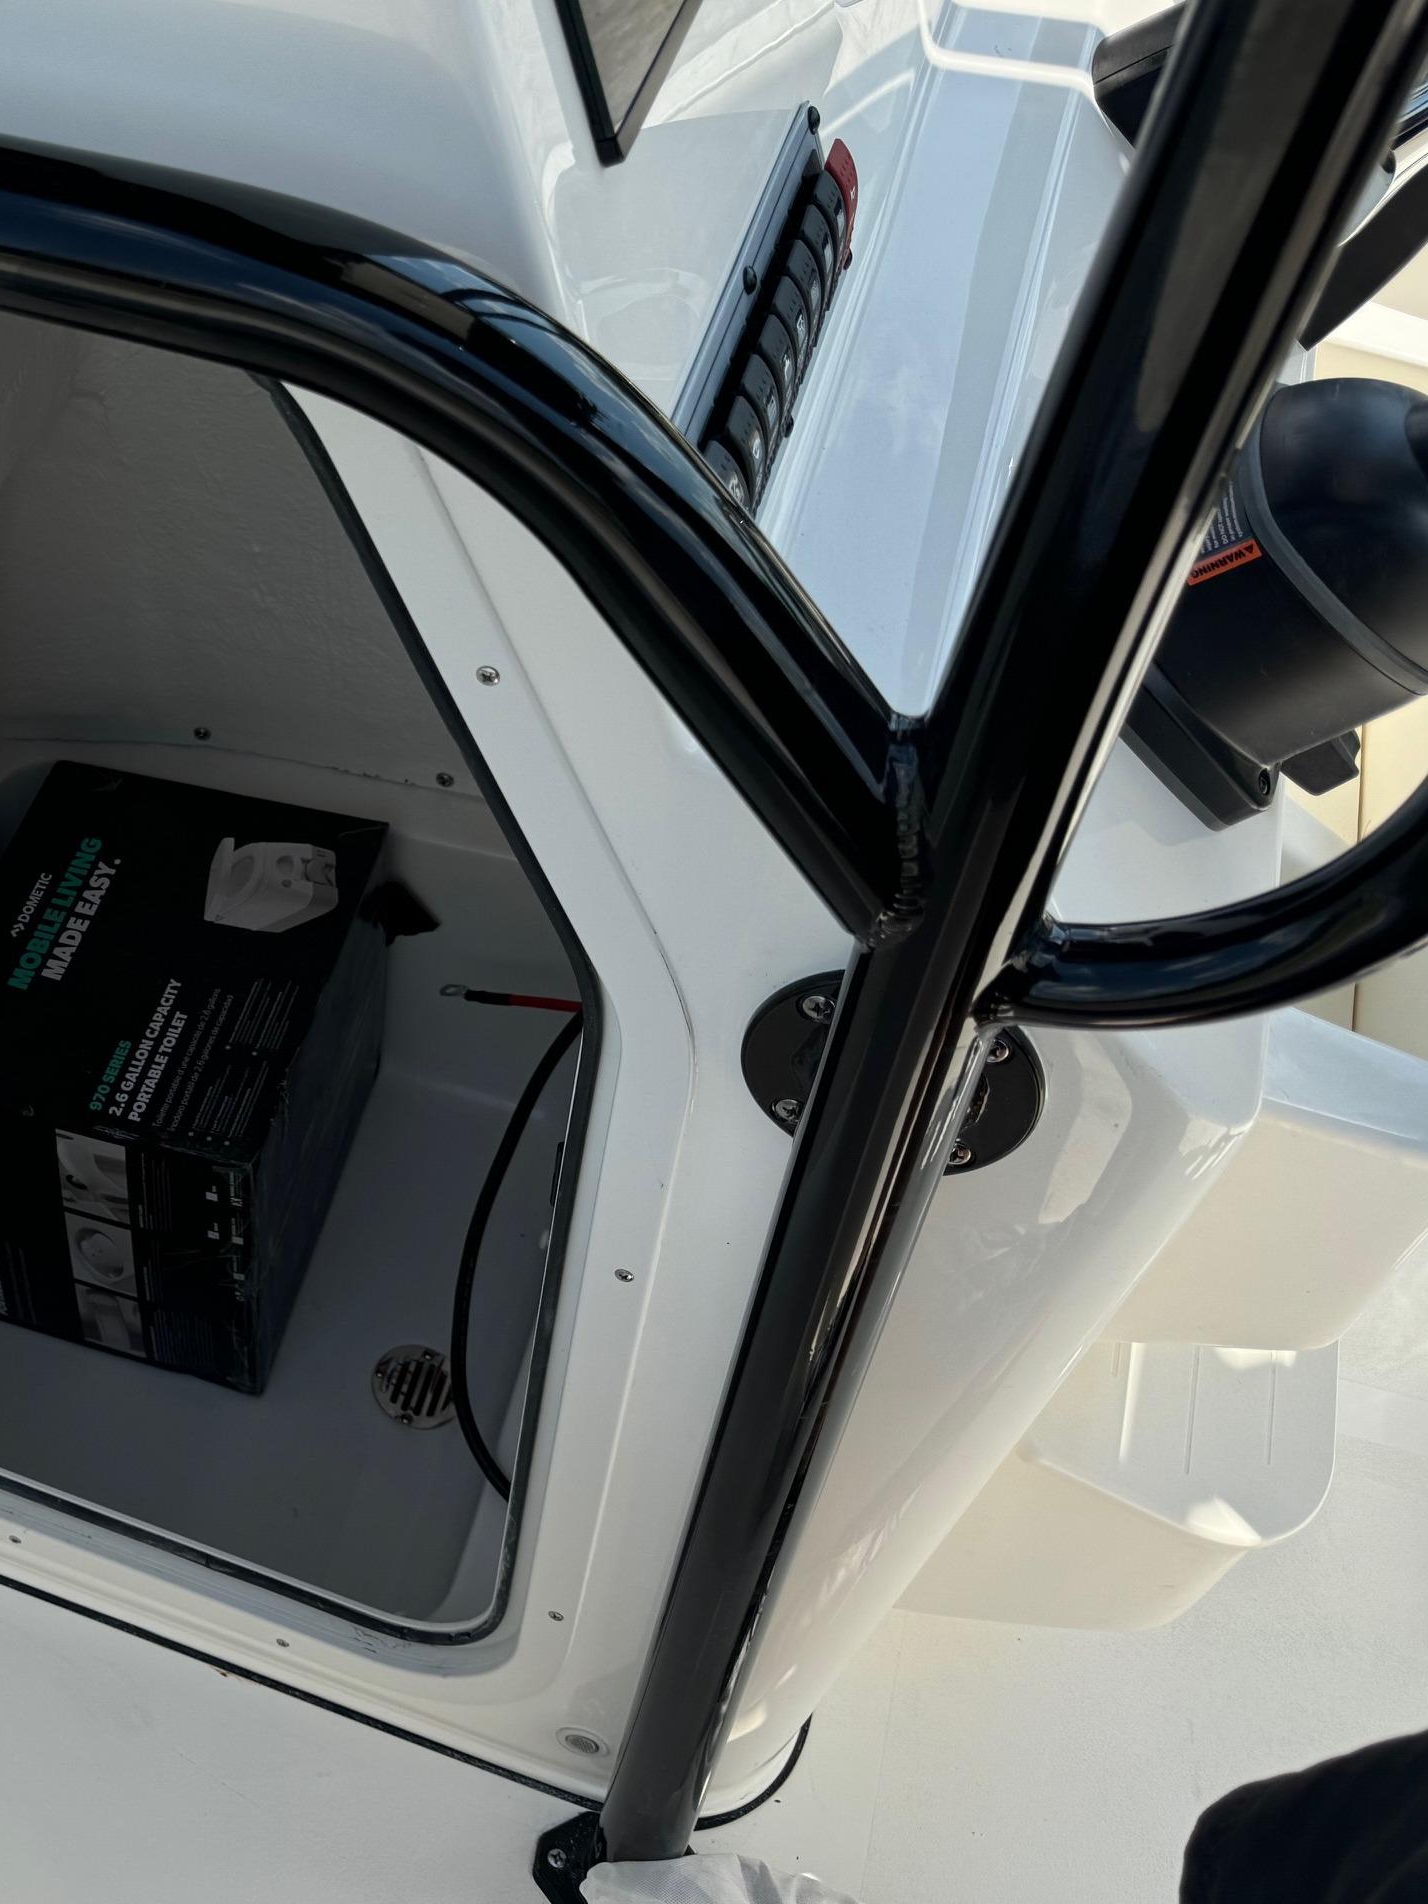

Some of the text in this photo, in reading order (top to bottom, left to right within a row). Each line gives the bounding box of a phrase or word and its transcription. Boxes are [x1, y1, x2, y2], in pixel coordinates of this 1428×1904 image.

[1191, 549, 1246, 578] WARNING
[6, 837, 102, 991] MOBILE LIVING
[17, 872, 53, 924] DOMETIC
[41, 858, 122, 981] MADE EASY.
[88, 1039, 132, 1112] 970 SERIES
[108, 978, 183, 1117] 2.6 GALLON CAPACITY
[128, 1054, 170, 1122] PORTABLE
[158, 1011, 189, 1054] TOILET
